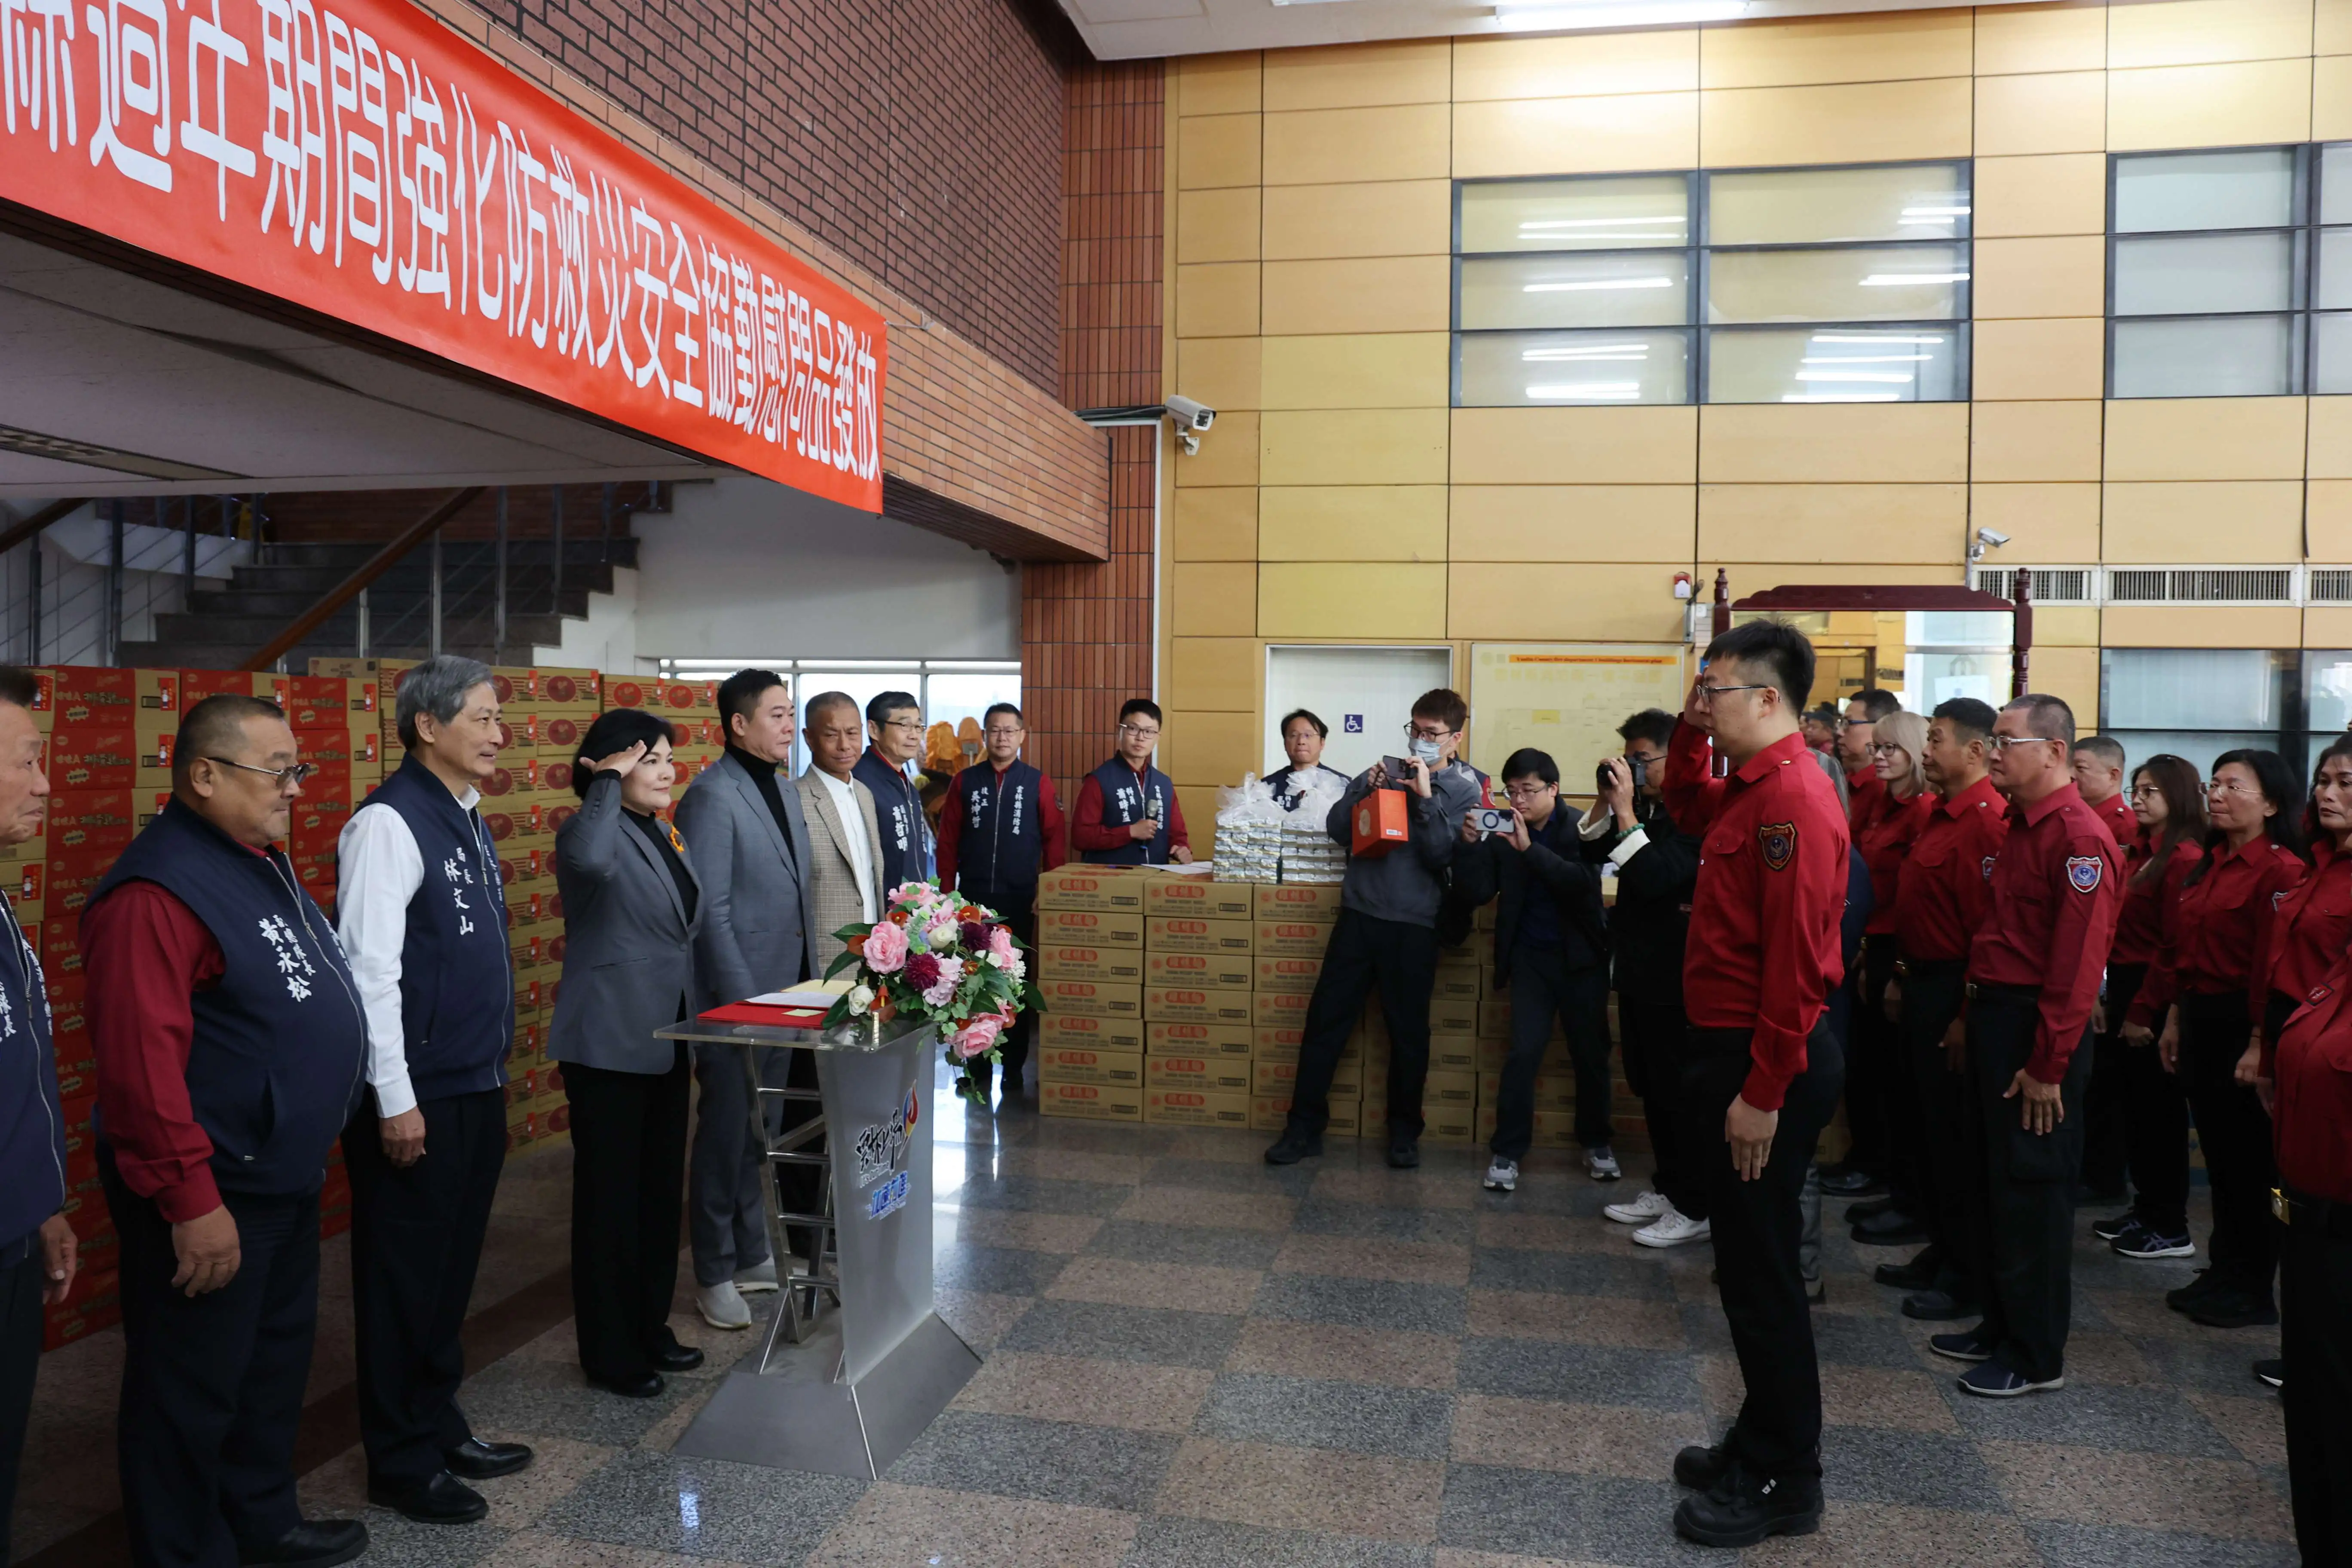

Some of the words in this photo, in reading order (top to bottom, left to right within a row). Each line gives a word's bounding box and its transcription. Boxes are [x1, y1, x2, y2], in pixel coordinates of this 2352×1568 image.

[1012, 785, 1024, 835] 雲林縣消防局
[444, 858, 475, 936] 林文山
[258, 918, 312, 1002] 黃永松
